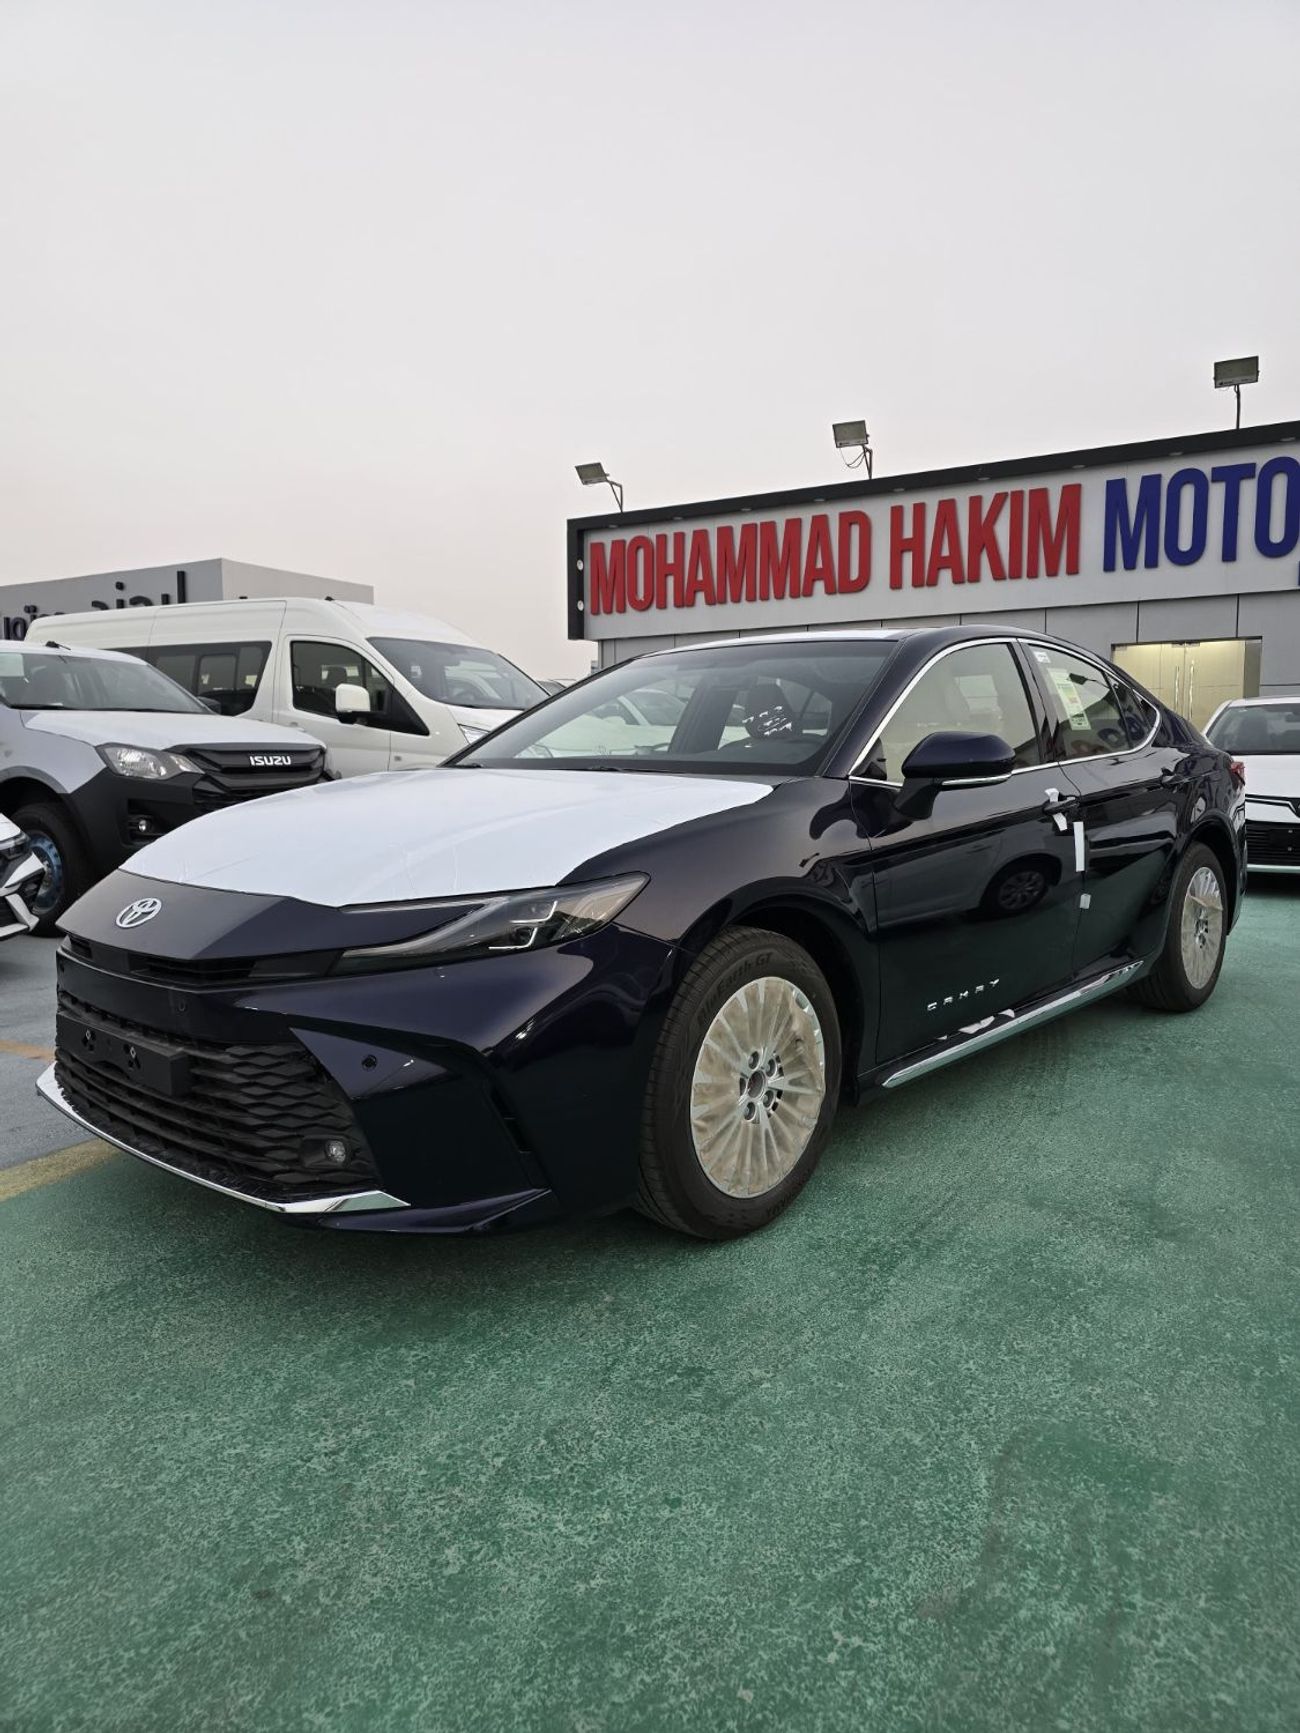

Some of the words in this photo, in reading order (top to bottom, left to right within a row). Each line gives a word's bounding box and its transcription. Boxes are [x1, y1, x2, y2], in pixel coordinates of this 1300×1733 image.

[588, 509, 873, 616] MOHAMMAD
[888, 483, 1082, 591] HAKIM
[1103, 456, 1300, 573] MOTO
[249, 755, 292, 766] ISUZU
[926, 978, 1001, 1012] CAMRY
